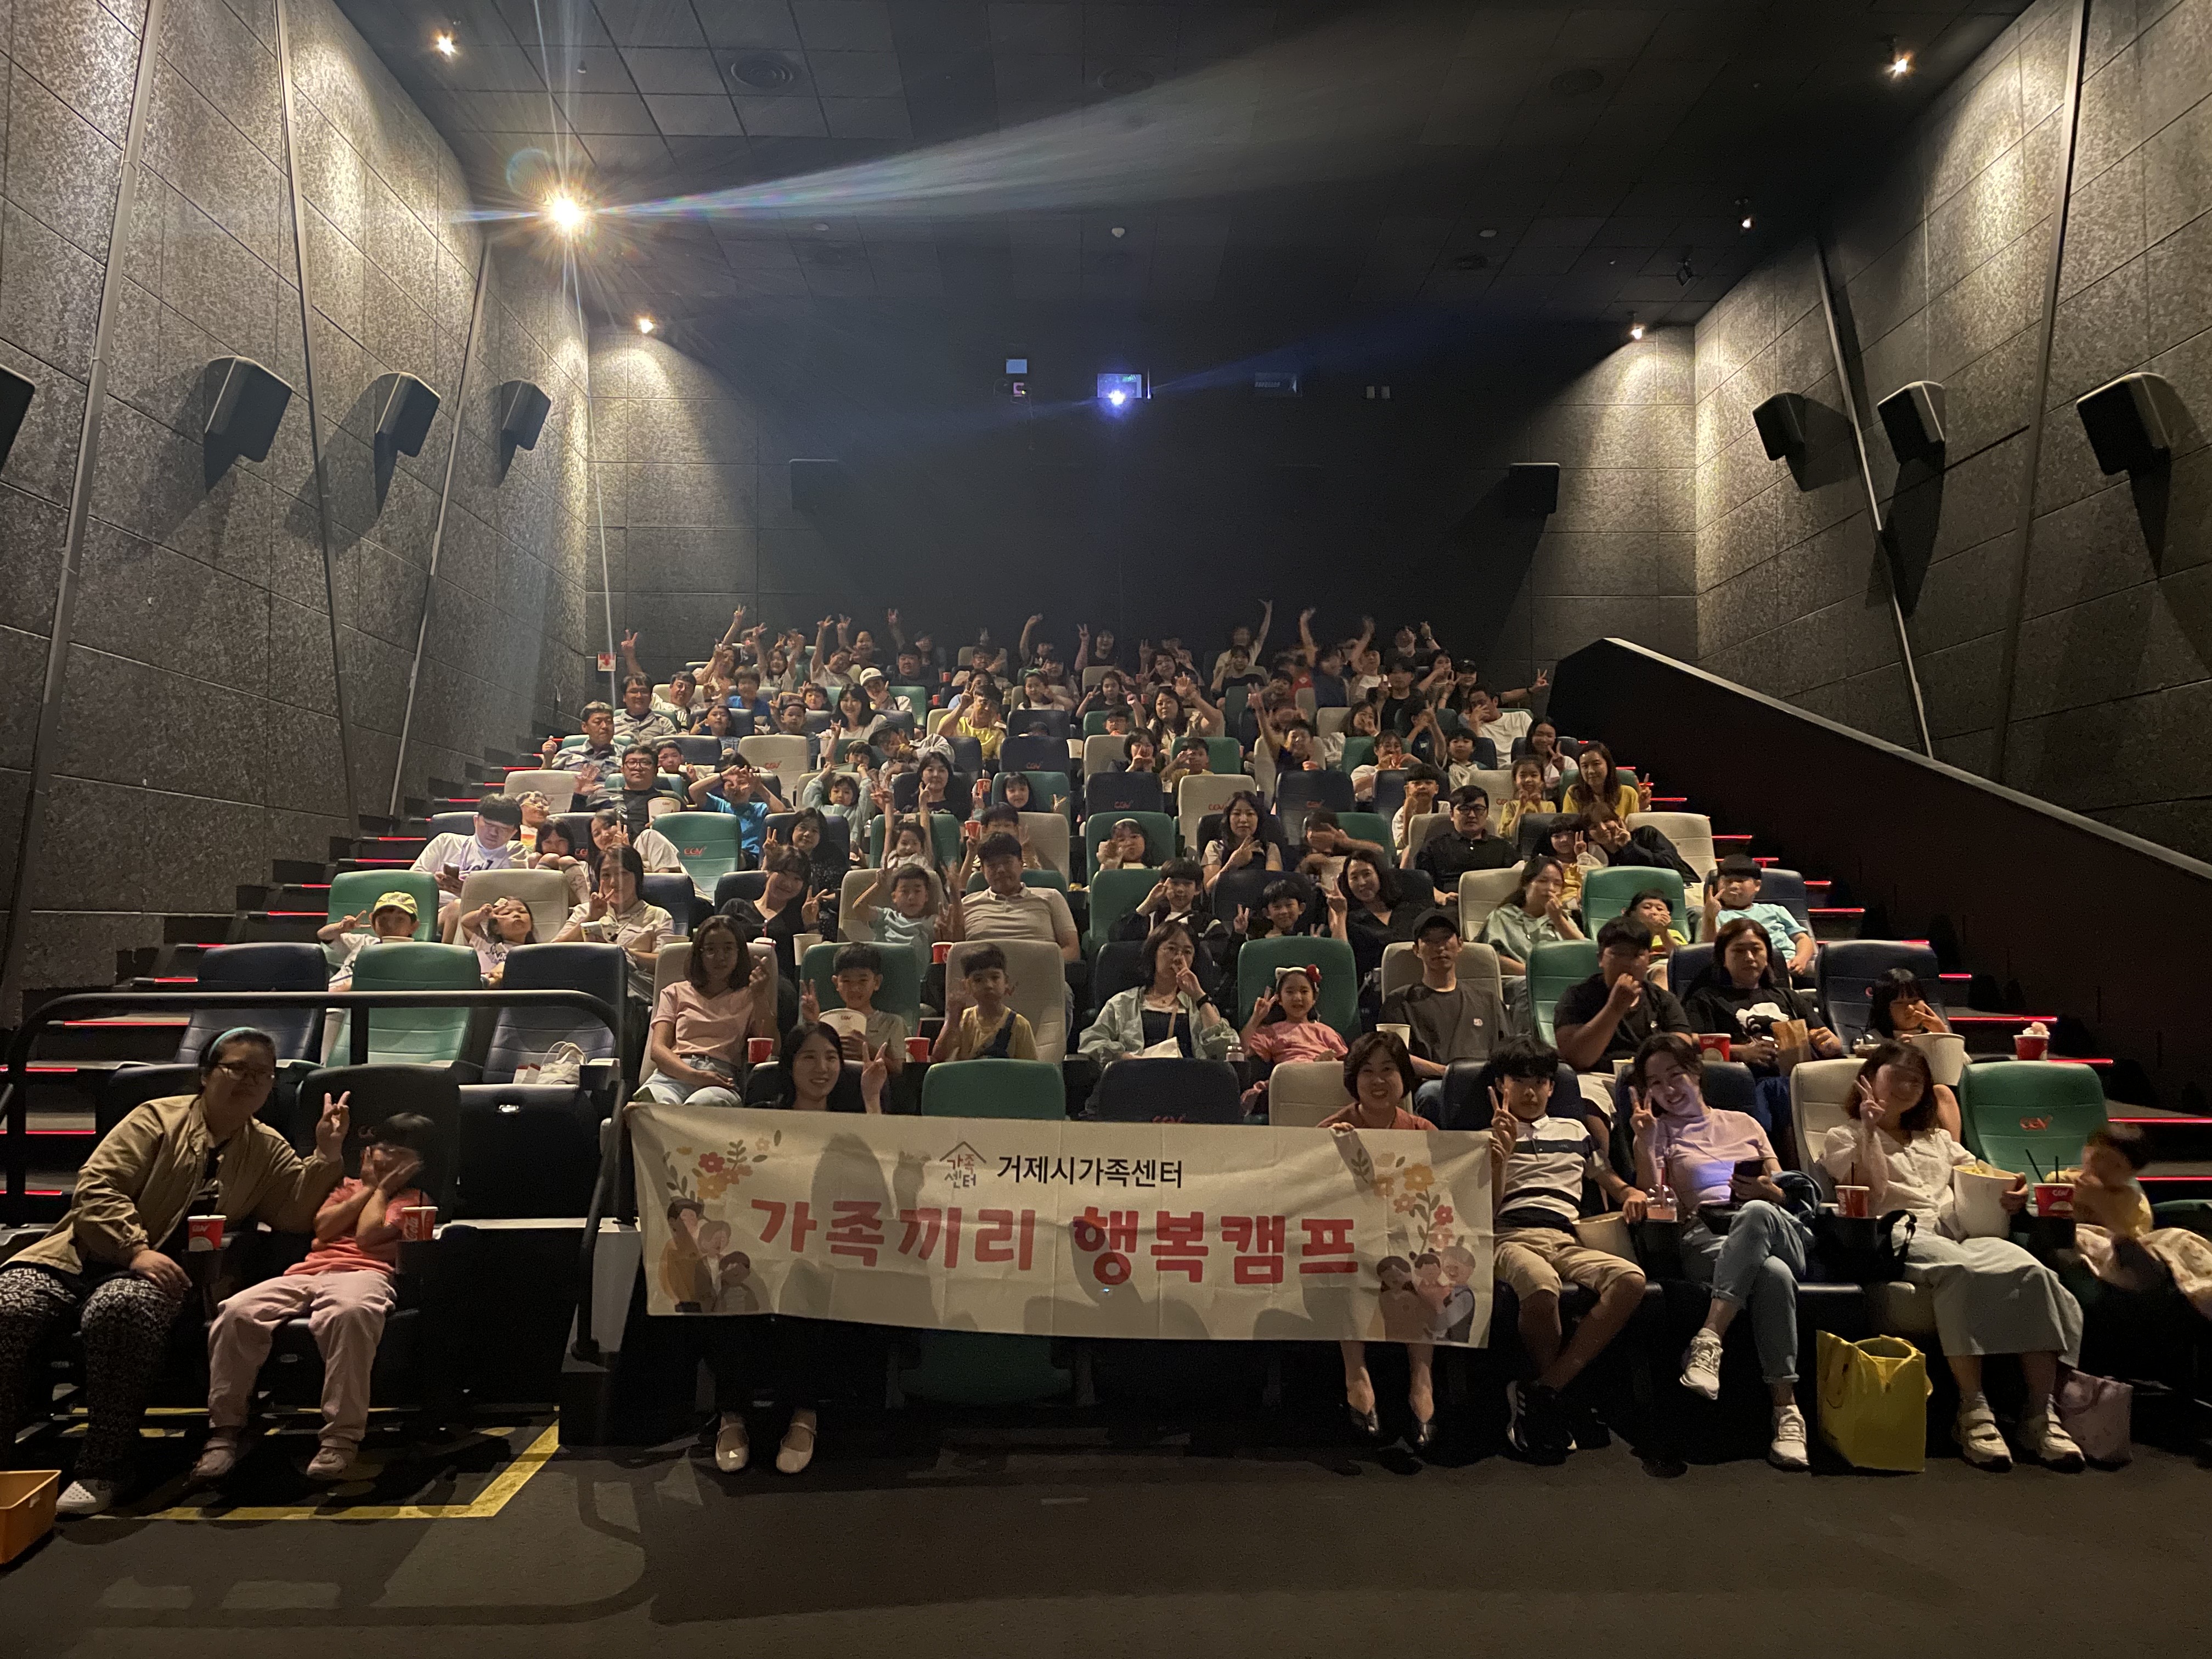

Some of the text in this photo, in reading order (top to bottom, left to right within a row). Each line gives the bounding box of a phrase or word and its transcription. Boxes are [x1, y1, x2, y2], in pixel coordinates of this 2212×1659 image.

[574, 848, 588, 857] CG
[684, 847, 706, 856] CGV
[946, 1153, 975, 1175] 가족
[996, 1154, 1183, 1188] 거제시가족센터
[944, 1171, 977, 1189] 센터
[751, 1199, 1358, 1285] 가족끼리 행복캠프
